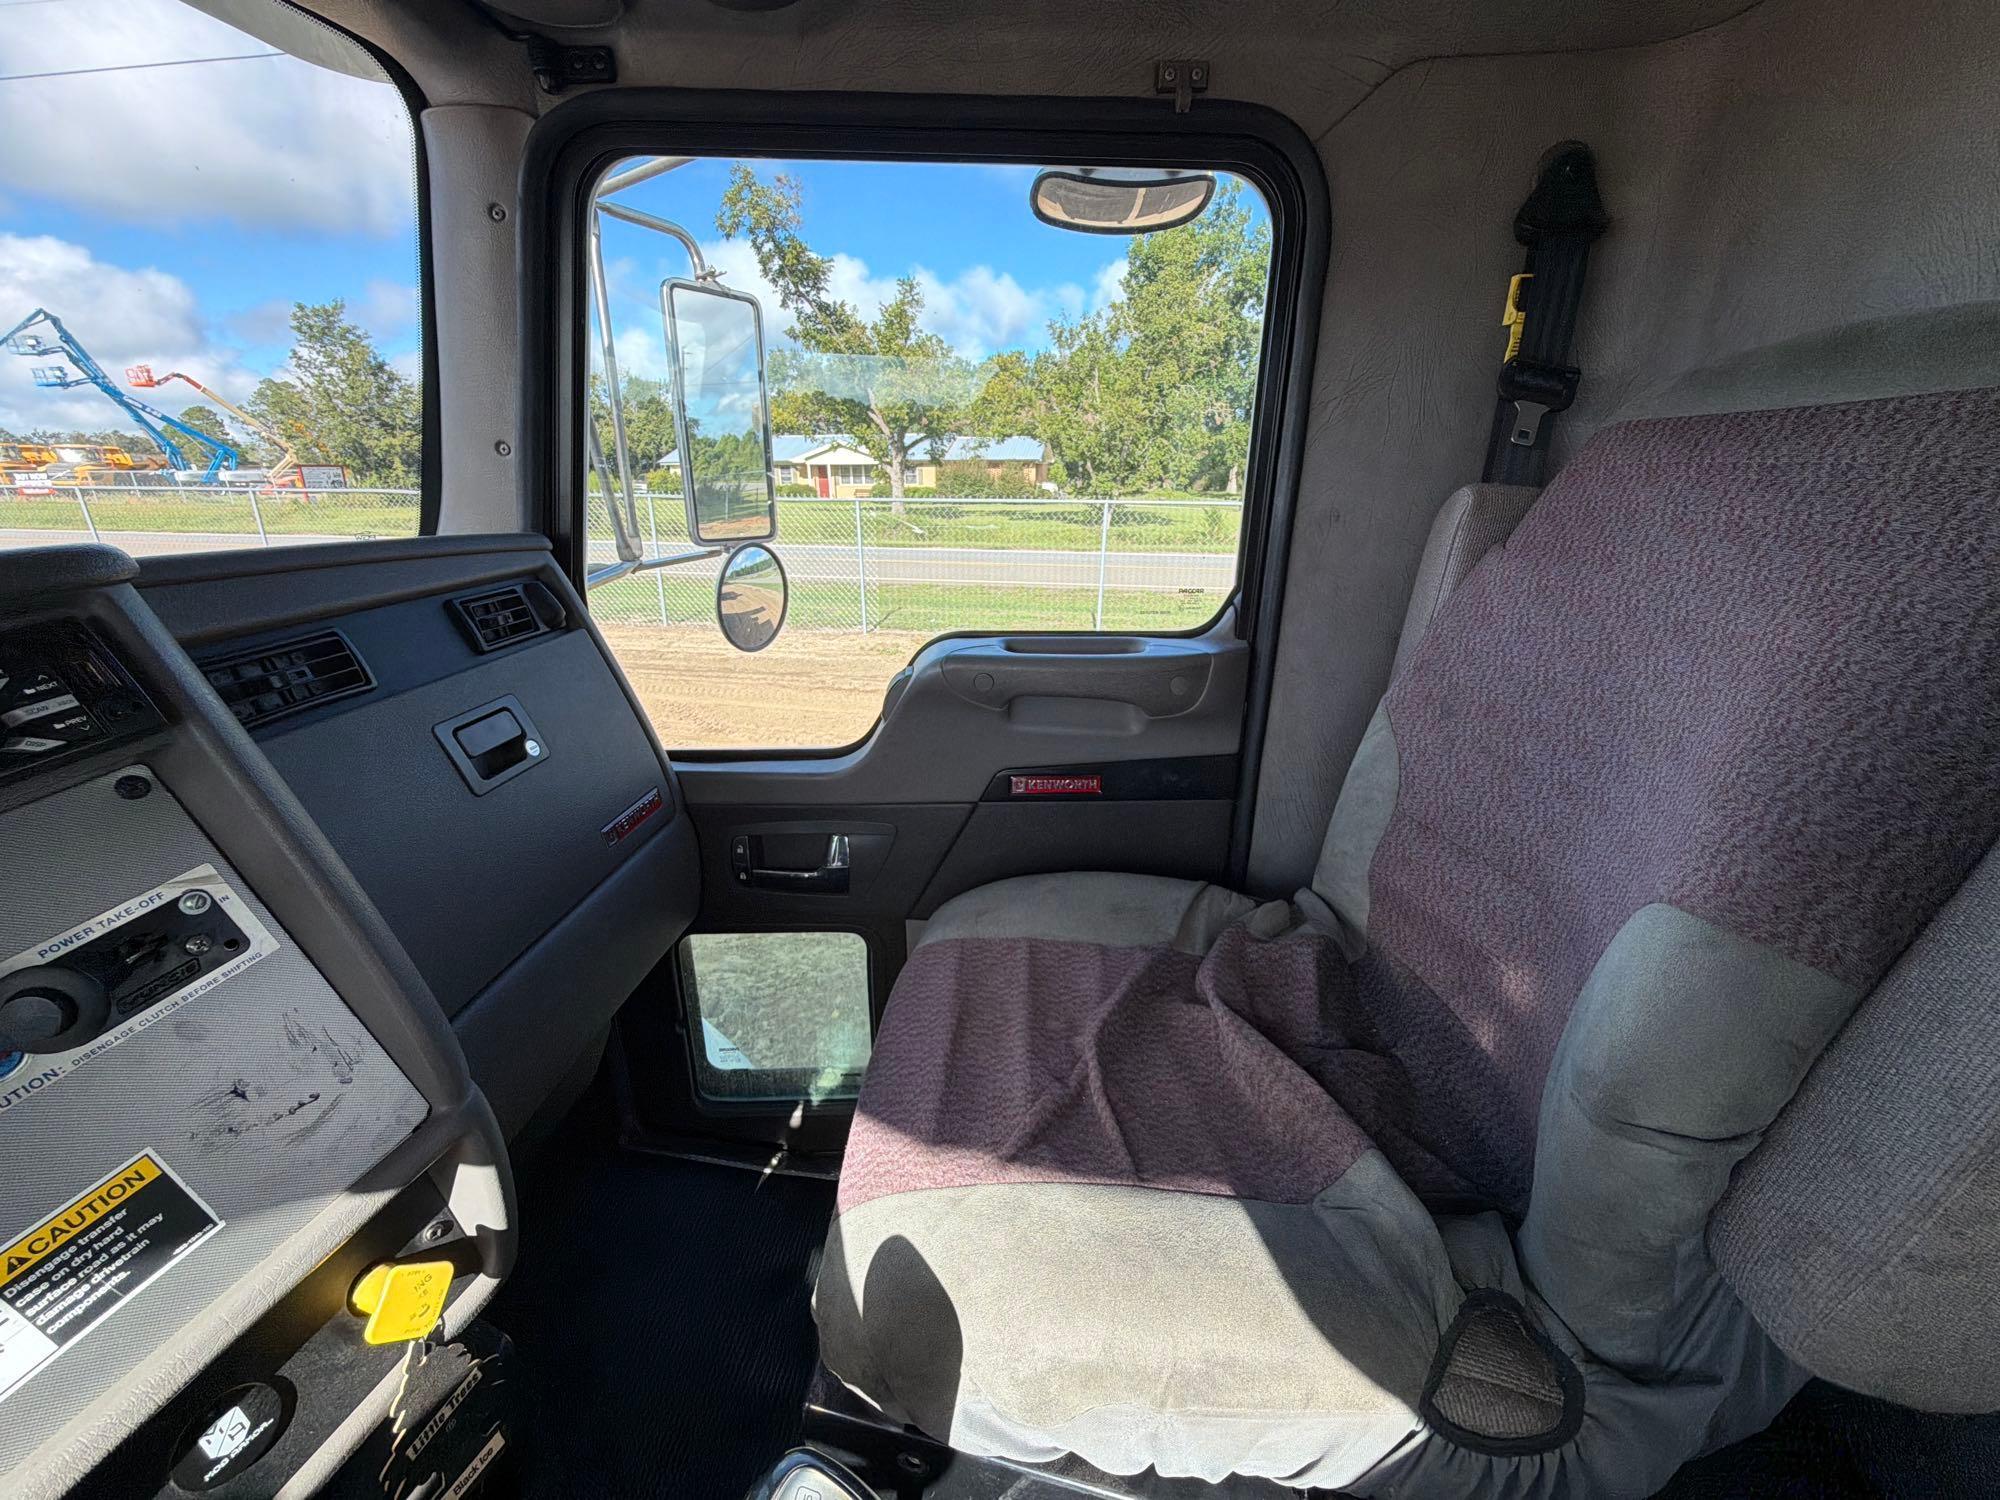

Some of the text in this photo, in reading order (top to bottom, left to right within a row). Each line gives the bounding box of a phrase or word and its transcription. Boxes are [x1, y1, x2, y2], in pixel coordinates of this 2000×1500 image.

[36, 681, 58, 691] NEXT
[64, 715, 87, 726] PREV
[1028, 779, 1098, 790] KENWORTH
[38, 891, 165, 959] POWER TAKE-OFF
[218, 894, 230, 904] IN
[71, 1026, 136, 1066] DISENGAGE
[138, 998, 180, 1027] CLUTCH
[181, 977, 220, 1002] BEFORE
[221, 951, 263, 978] SHIFTING
[27, 1169, 146, 1254] CAUTION
[3, 1245, 78, 1298] Disengage
[78, 1208, 129, 1246] transfer
[15, 1226, 125, 1308] case on dry hard
[24, 1212, 164, 1317] surface road as it may
[35, 1284, 92, 1326] damage
[90, 1238, 151, 1285] drivetrain
[46, 1270, 132, 1335] components.
[412, 1373, 479, 1454] Little Trees
[453, 1447, 494, 1495] Black Ice
